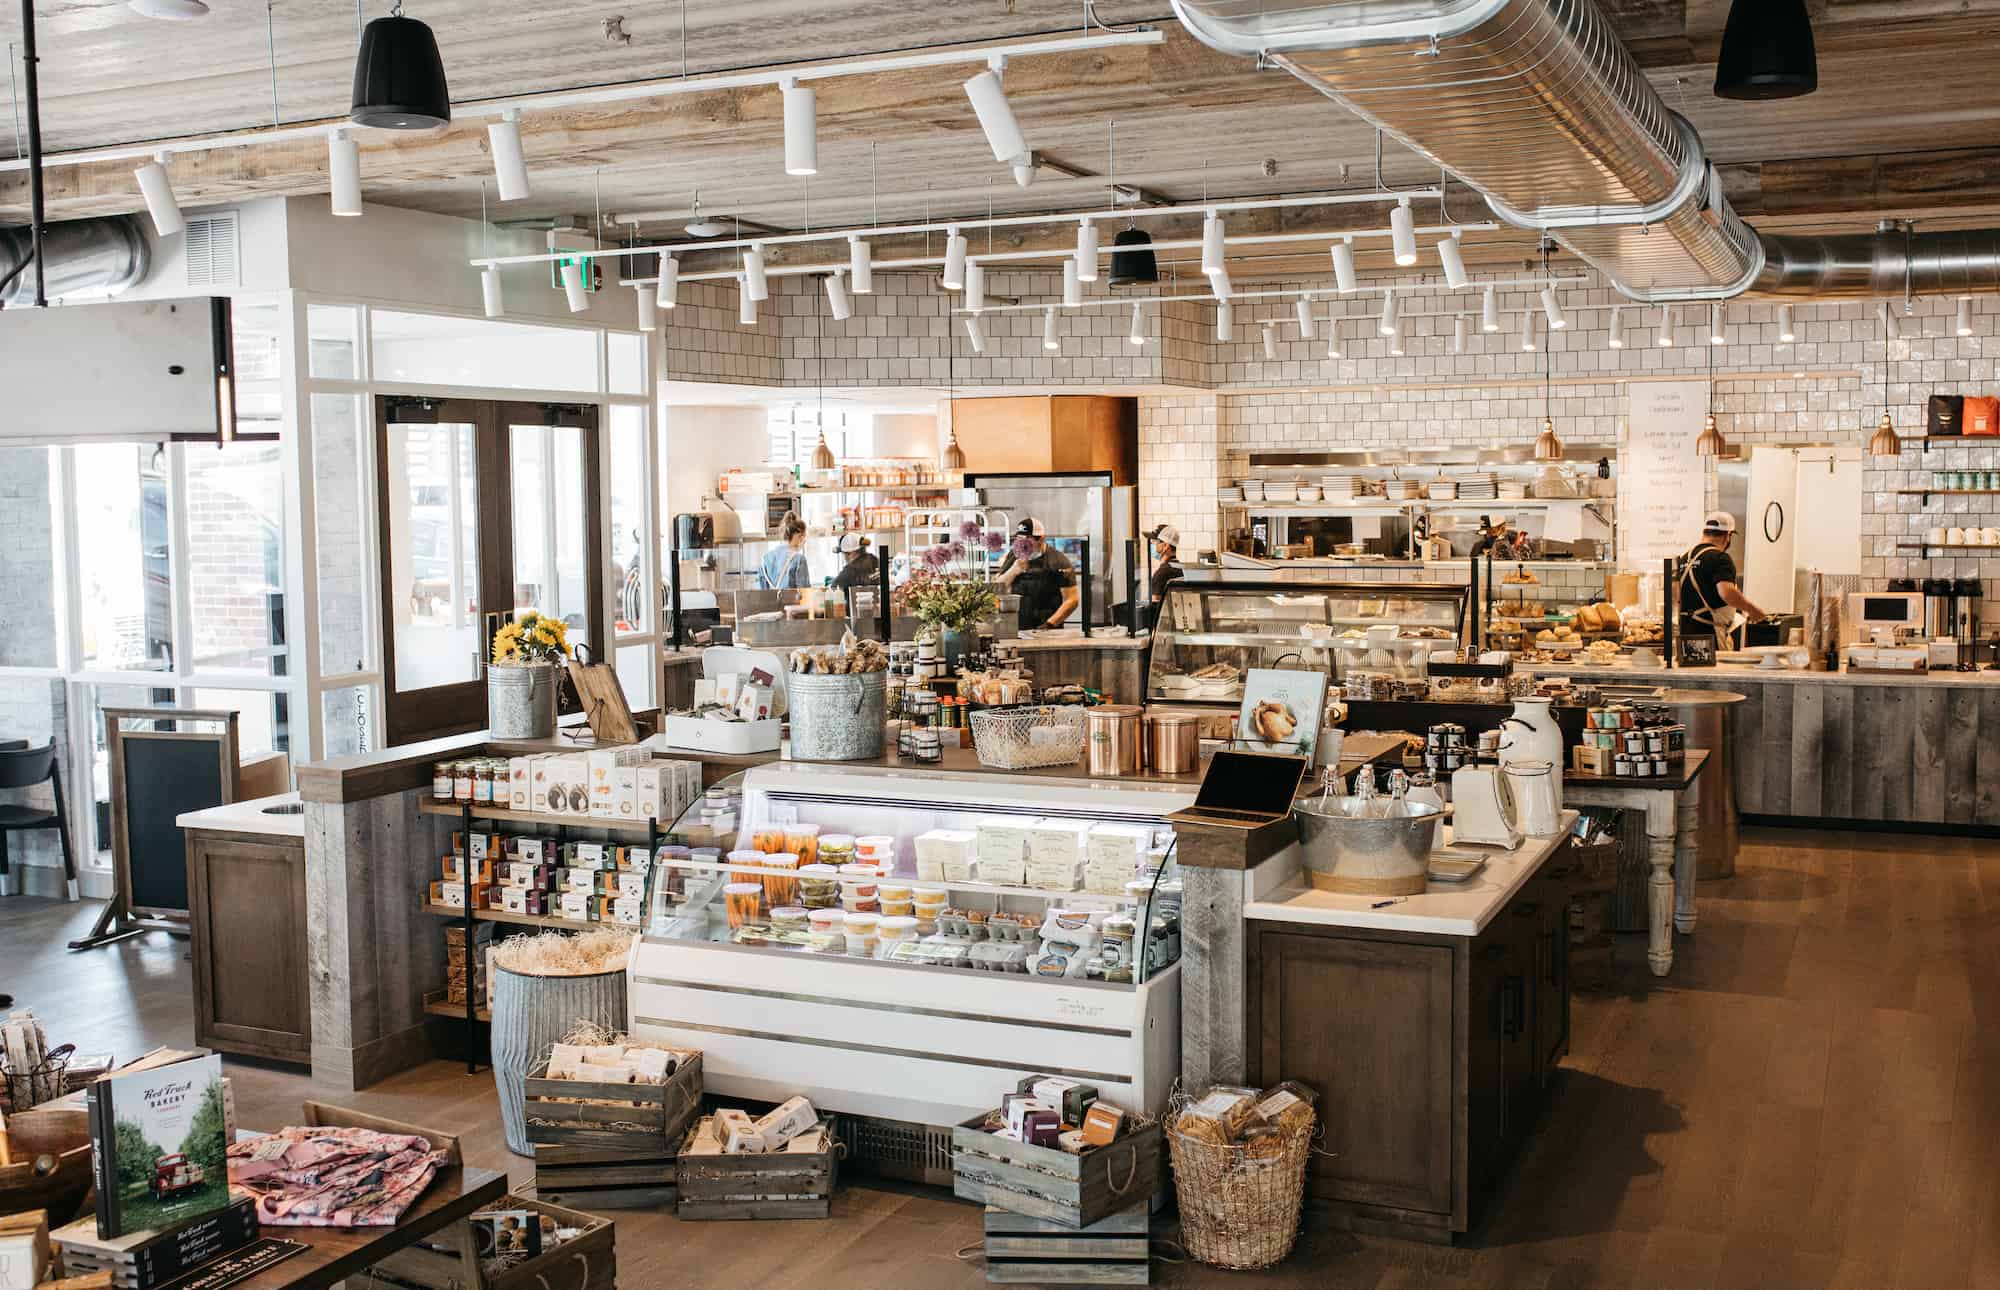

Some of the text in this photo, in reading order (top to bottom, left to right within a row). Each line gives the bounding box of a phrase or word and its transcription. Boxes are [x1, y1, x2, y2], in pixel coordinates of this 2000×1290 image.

[144, 1080, 192, 1101] Red Truck
[150, 1094, 185, 1108] BAKERY
